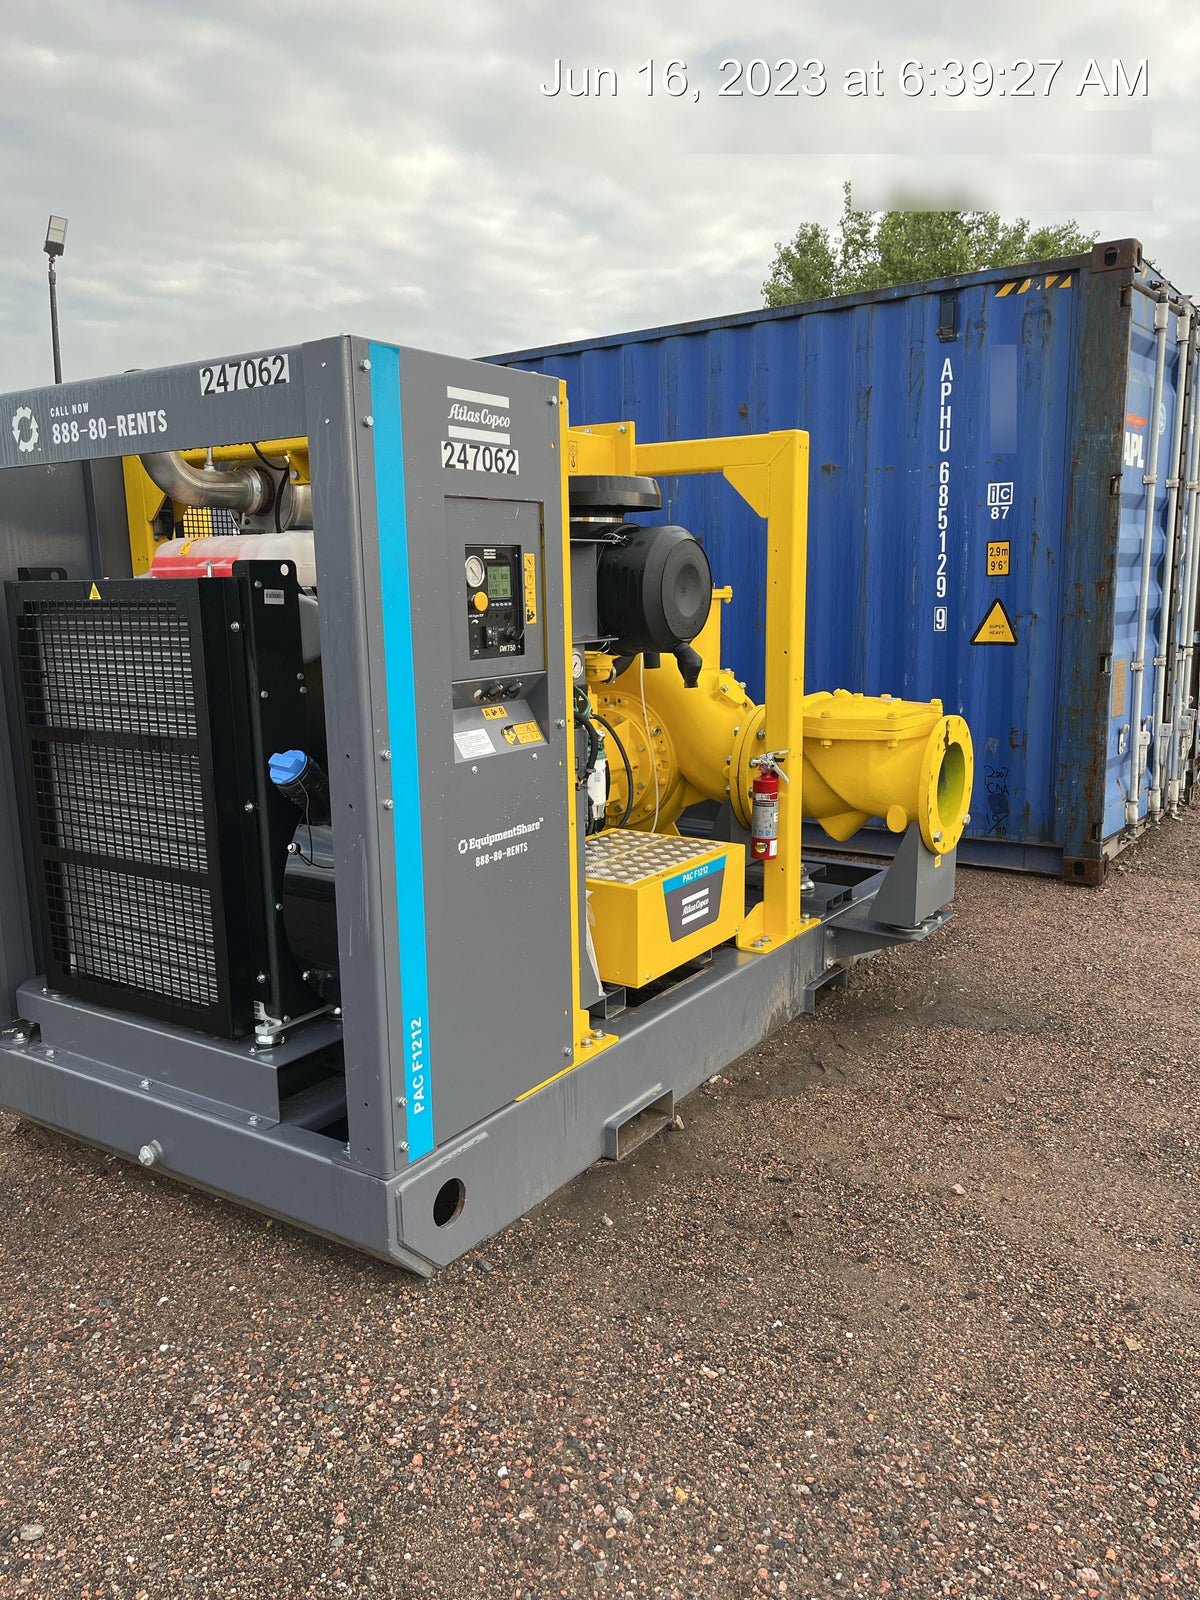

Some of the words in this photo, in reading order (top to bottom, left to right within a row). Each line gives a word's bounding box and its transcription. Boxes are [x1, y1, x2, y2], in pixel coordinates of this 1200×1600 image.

[201, 354, 288, 396] 247062
[50, 403, 70, 418] CALL
[71, 401, 90, 415] NOW
[447, 403, 480, 423] Atlas
[480, 408, 511, 429] Copco
[939, 357, 954, 453] APHU
[52, 408, 168, 445] 888-80-RENTS
[443, 441, 517, 475] 247062
[1123, 431, 1145, 469] APL
[935, 461, 950, 599] 685129
[990, 506, 1010, 520] 87
[475, 841, 529, 867] 888-80-RENTS
[682, 871, 694, 884] PAC
[694, 865, 709, 879] F1212
[410, 1016, 424, 1073] F1212
[412, 1074, 425, 1115] PAC
